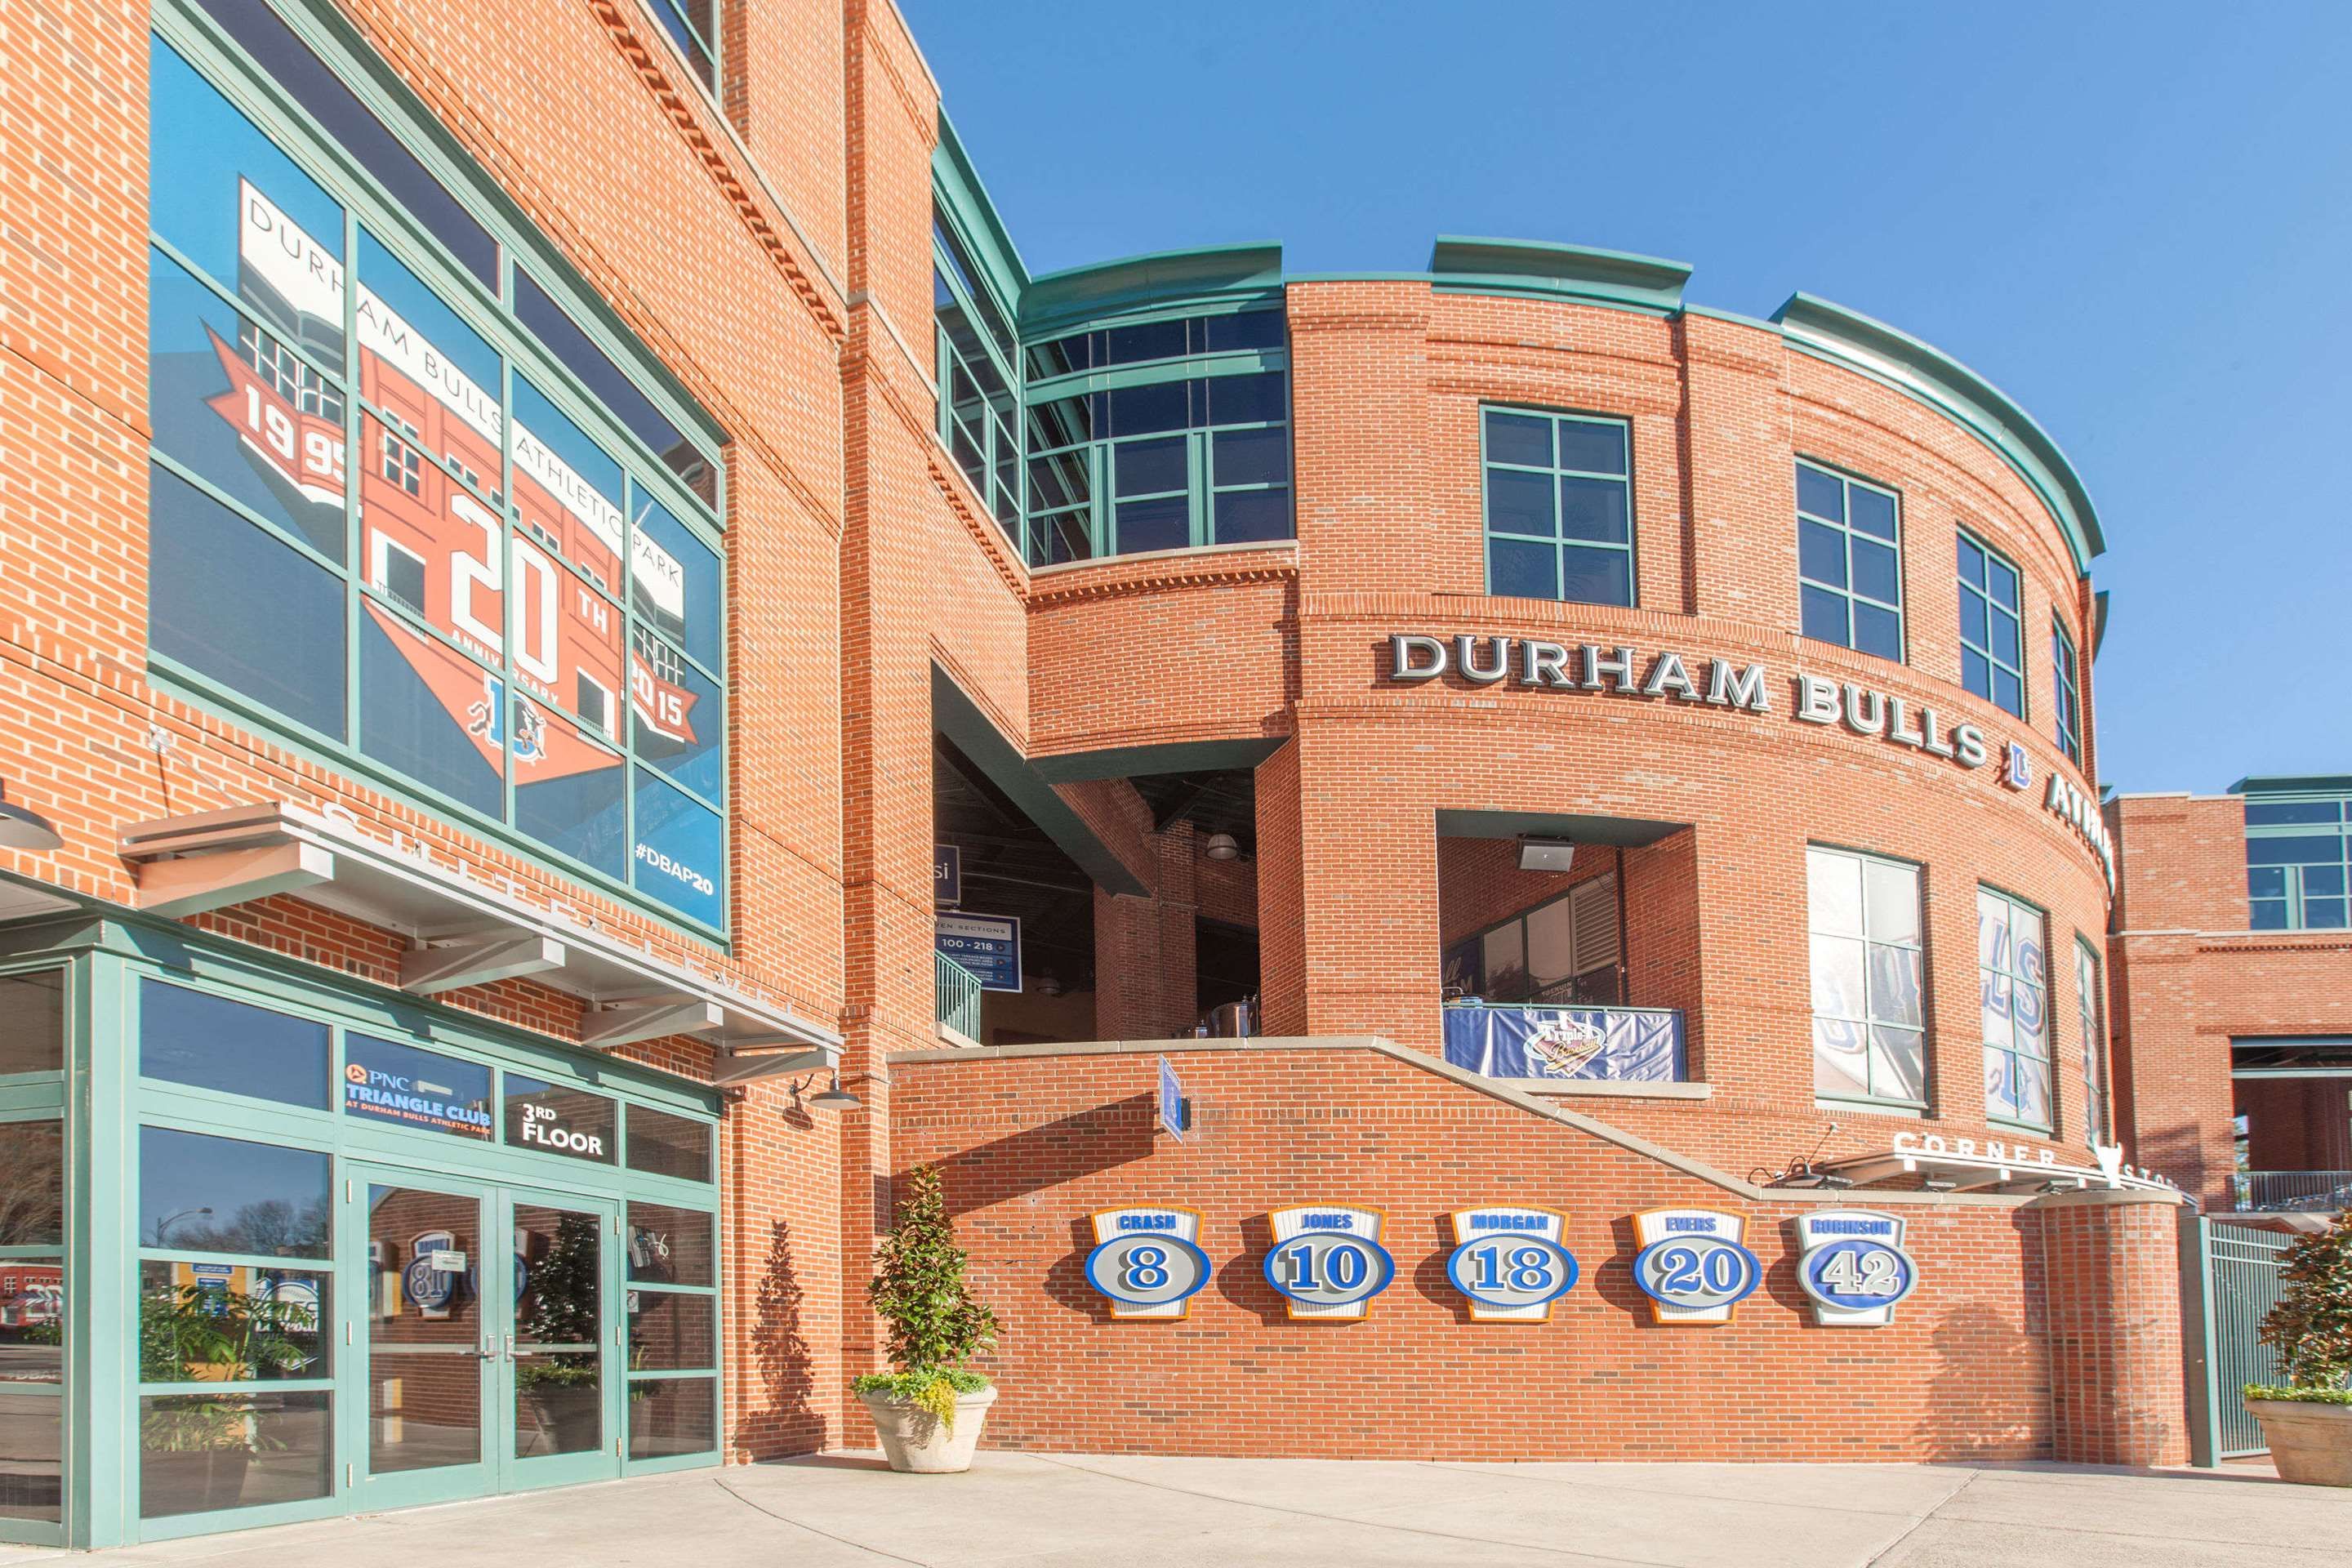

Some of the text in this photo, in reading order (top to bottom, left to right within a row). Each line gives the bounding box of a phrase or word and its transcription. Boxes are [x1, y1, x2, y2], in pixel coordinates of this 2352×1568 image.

[250, 198, 679, 588] DURHAM BULLS ATHLETIC PARK
[452, 494, 608, 684] 20 TH
[452, 630, 559, 704] ANNIVRSARY
[1389, 634, 1987, 768] DURHAM BULLS
[635, 843, 714, 896] #DBAP20
[941, 938, 964, 949] 100
[973, 941, 993, 951] 218
[958, 924, 1006, 934] SECTIONS
[369, 1070, 410, 1092] PNC
[345, 1100, 491, 1134] AT DURHAM BULLS ATHLETIC PARK
[346, 1083, 491, 1126] TRIANGLE CLUB
[522, 1102, 556, 1123] 3RD
[522, 1122, 604, 1156] FLOOR
[1894, 1131, 2055, 1165] CORNER
[1120, 1214, 1176, 1230] CRASH
[1300, 1214, 1353, 1230] JONES
[1471, 1214, 1548, 1230] MORGAN
[1665, 1217, 1717, 1232] EVERS
[1811, 1218, 1892, 1235] ROBINSON
[1125, 1245, 1171, 1290] 8
[1288, 1243, 1369, 1290] 10
[1472, 1245, 1554, 1292] 18
[1661, 1245, 1745, 1294] 20
[1821, 1250, 1900, 1296] 42
